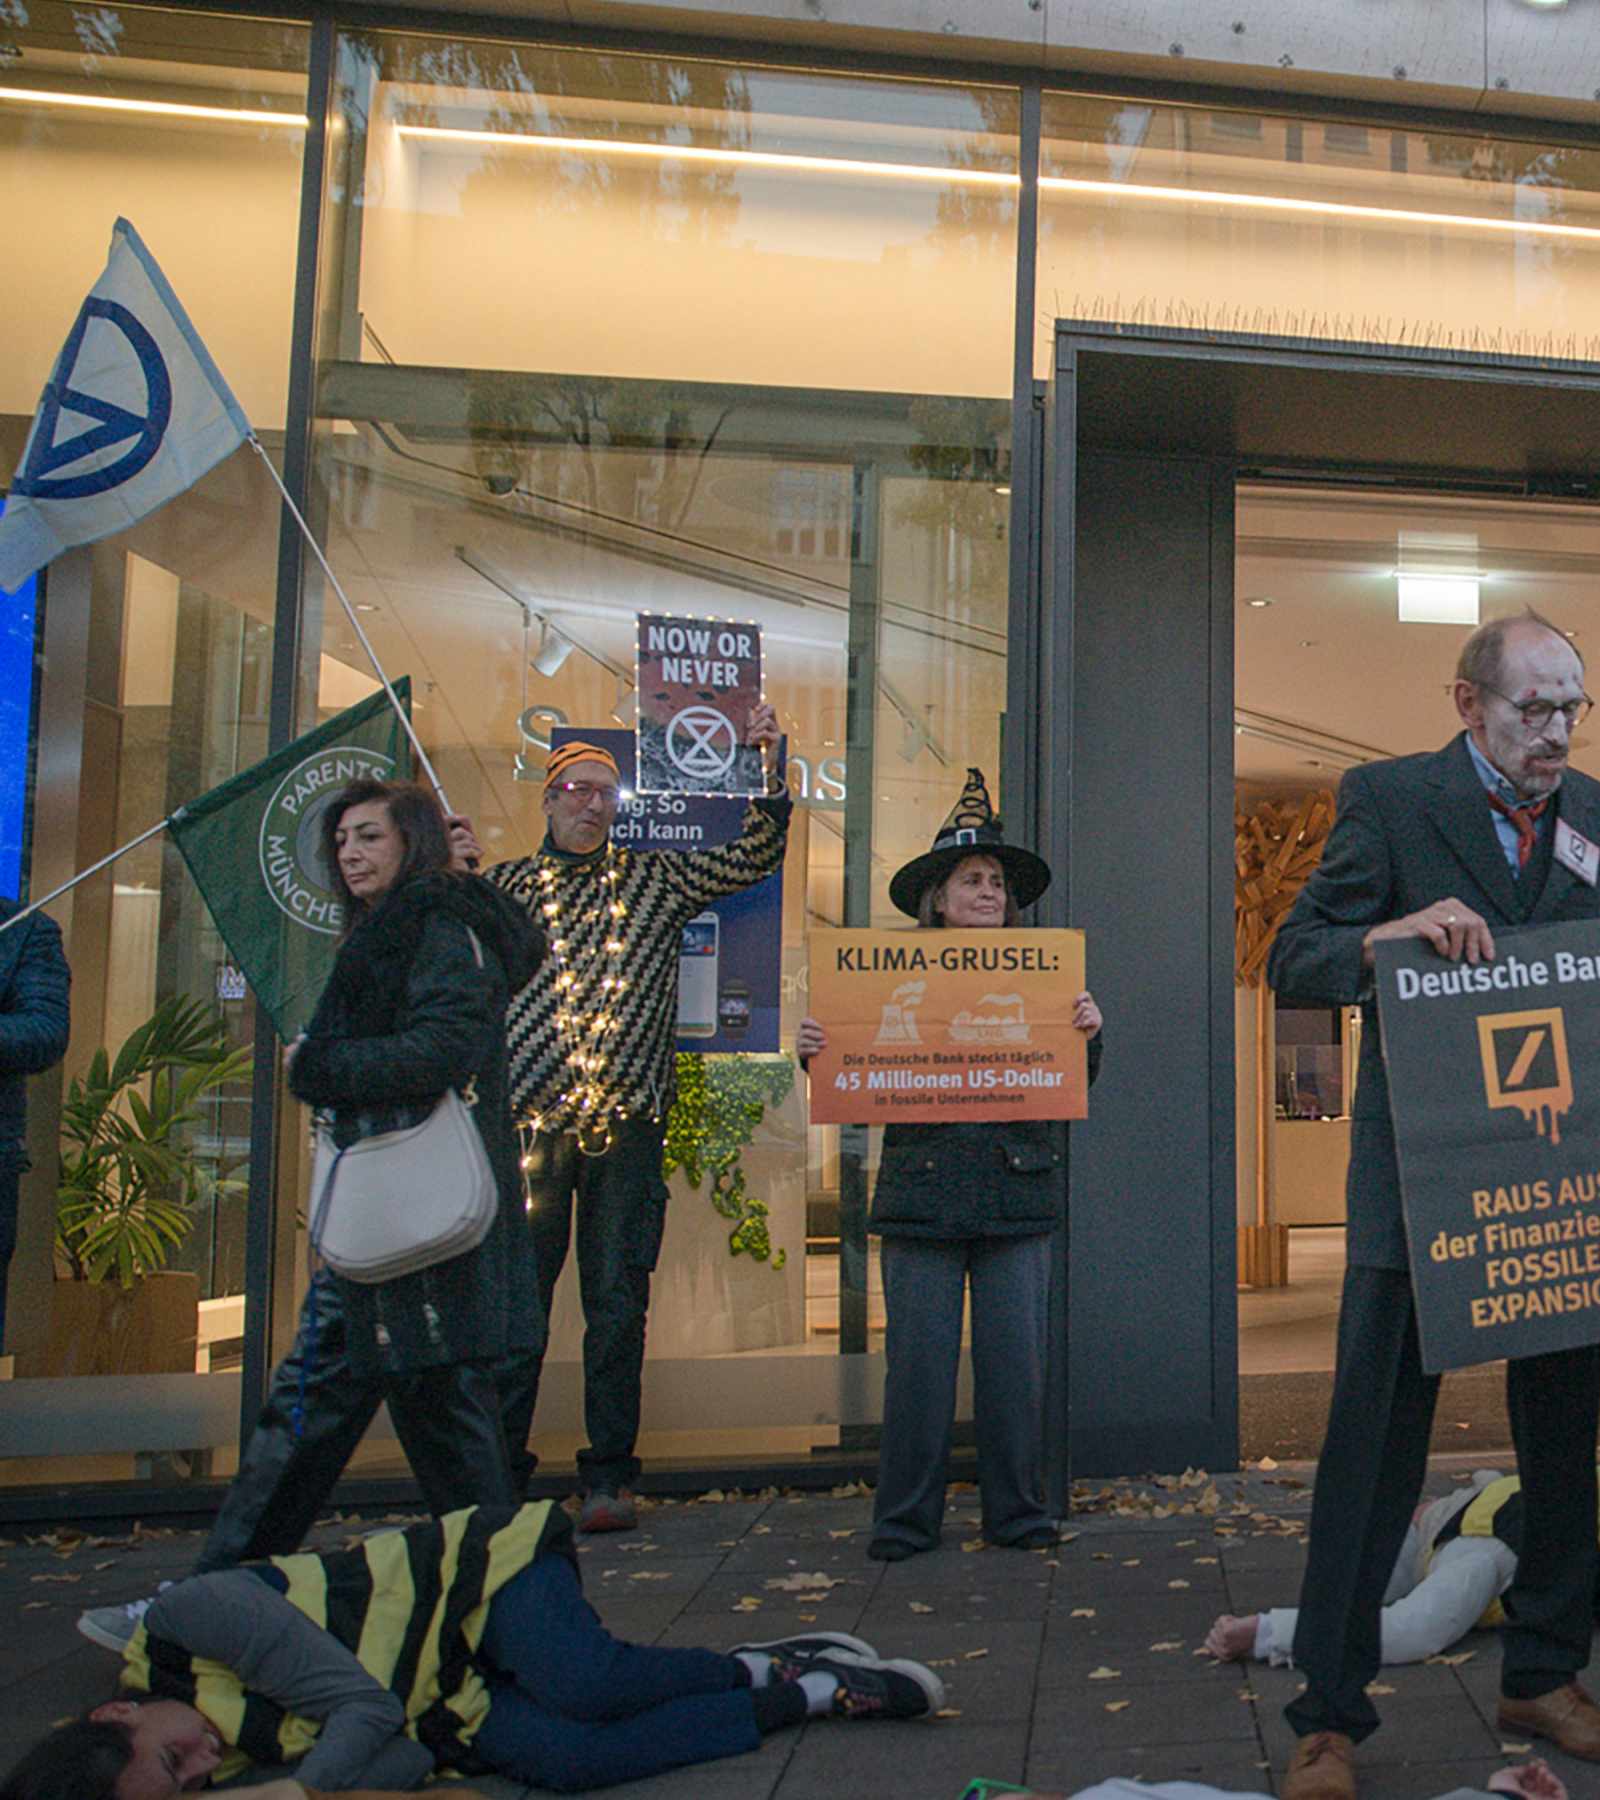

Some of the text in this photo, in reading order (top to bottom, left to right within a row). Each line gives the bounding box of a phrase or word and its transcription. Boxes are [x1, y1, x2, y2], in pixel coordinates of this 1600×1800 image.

[648, 625, 751, 659] NOW OR
[662, 658, 739, 687] NEVER
[657, 795, 687, 814] So
[649, 818, 703, 840] kann
[836, 946, 1060, 972] KLIMA-GRUSEL:
[1396, 955, 1549, 1000] Deutsche
[843, 1050, 1055, 1066] Die Deutsche Bank steckt täglich
[834, 1068, 1064, 1091] 45 Millionen US-Dollar
[874, 1092, 1025, 1106] in fossile Unternehmen
[1472, 1181, 1551, 1220] RAUS
[1430, 1232, 1477, 1263] der
